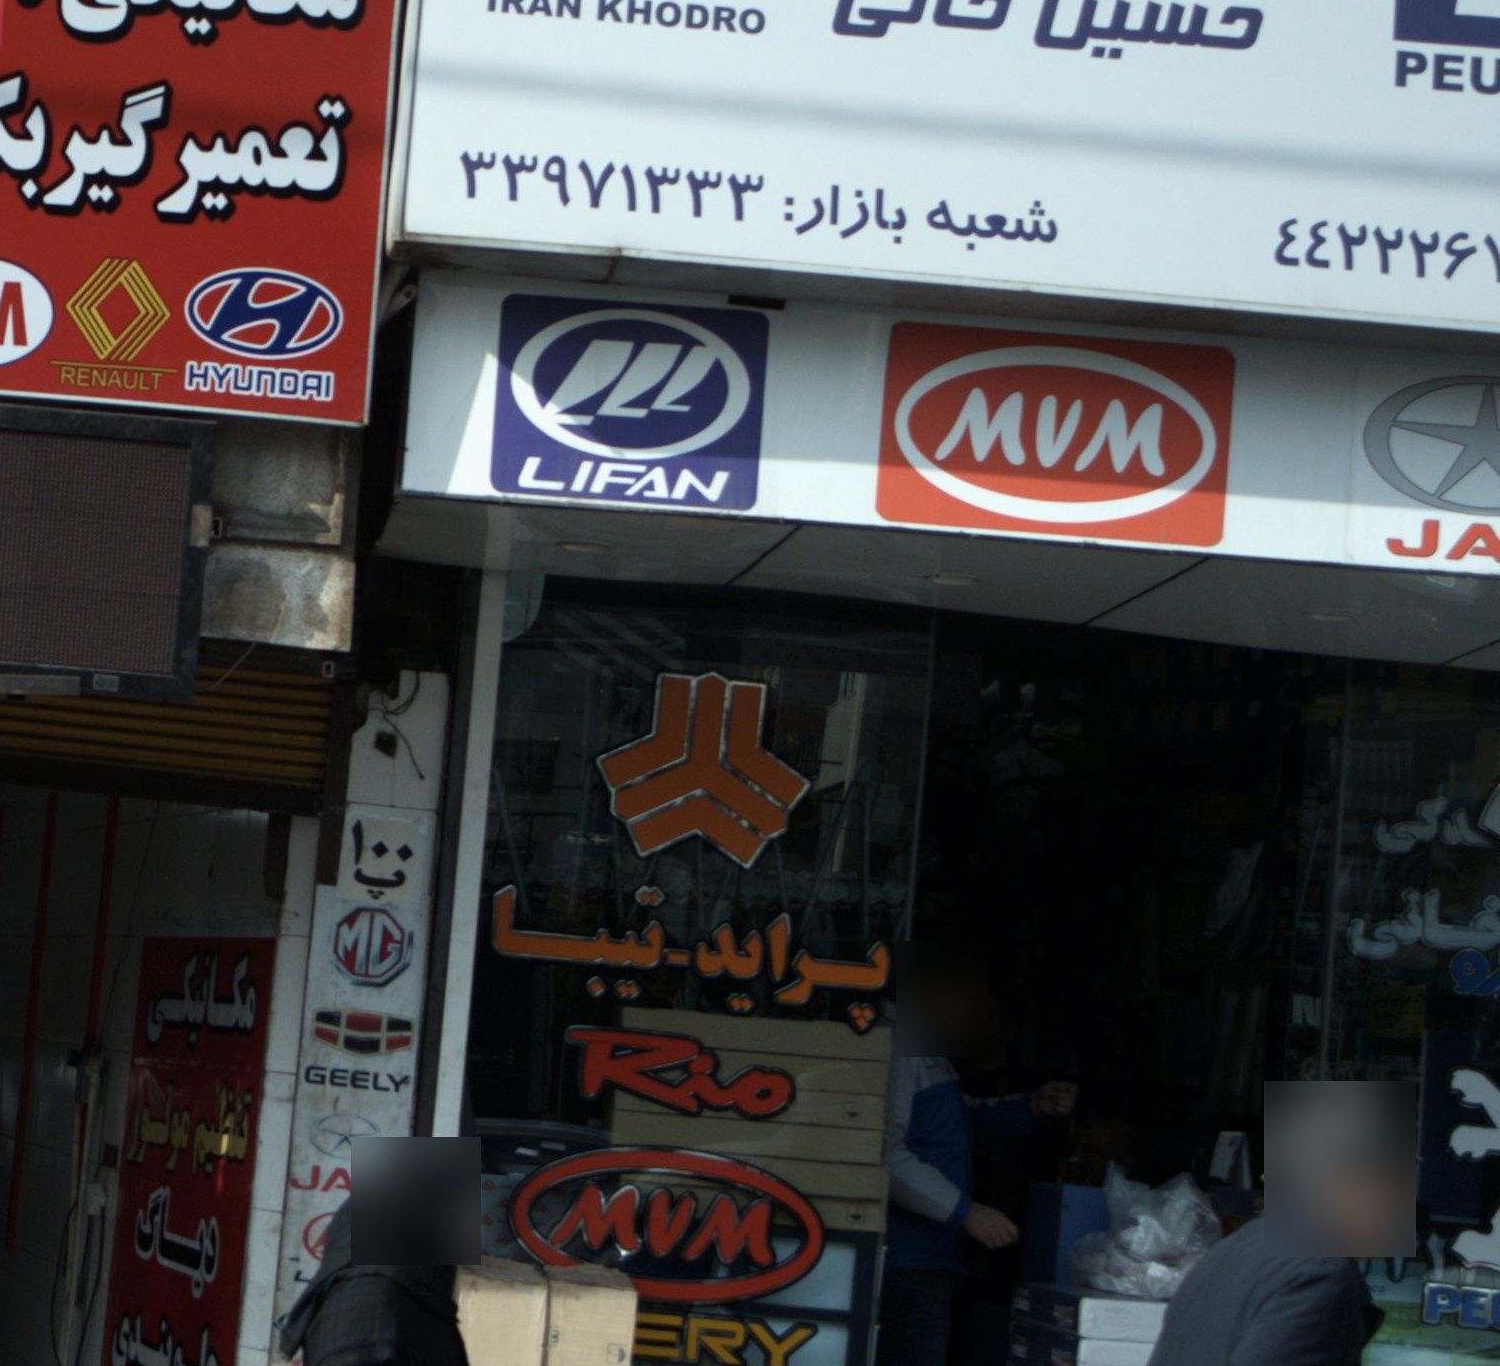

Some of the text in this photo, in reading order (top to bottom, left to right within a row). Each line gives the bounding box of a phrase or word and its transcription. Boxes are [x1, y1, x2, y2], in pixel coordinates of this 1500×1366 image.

[154, 92, 353, 225] تعمیر
[458, 149, 766, 223] ۳۳۹۷۱۳۳۳
[926, 198, 1059, 251] شعبه
[59, 366, 165, 392] RENAULT
[184, 362, 336, 403] HYUNDAI
[933, 385, 1167, 478] MVM
[517, 454, 730, 503] LIFAN
[304, 1065, 411, 1094] GEELY
[565, 1024, 797, 1117] Rio
[290, 1163, 352, 1193] JA
[550, 1184, 776, 1267] MVM
